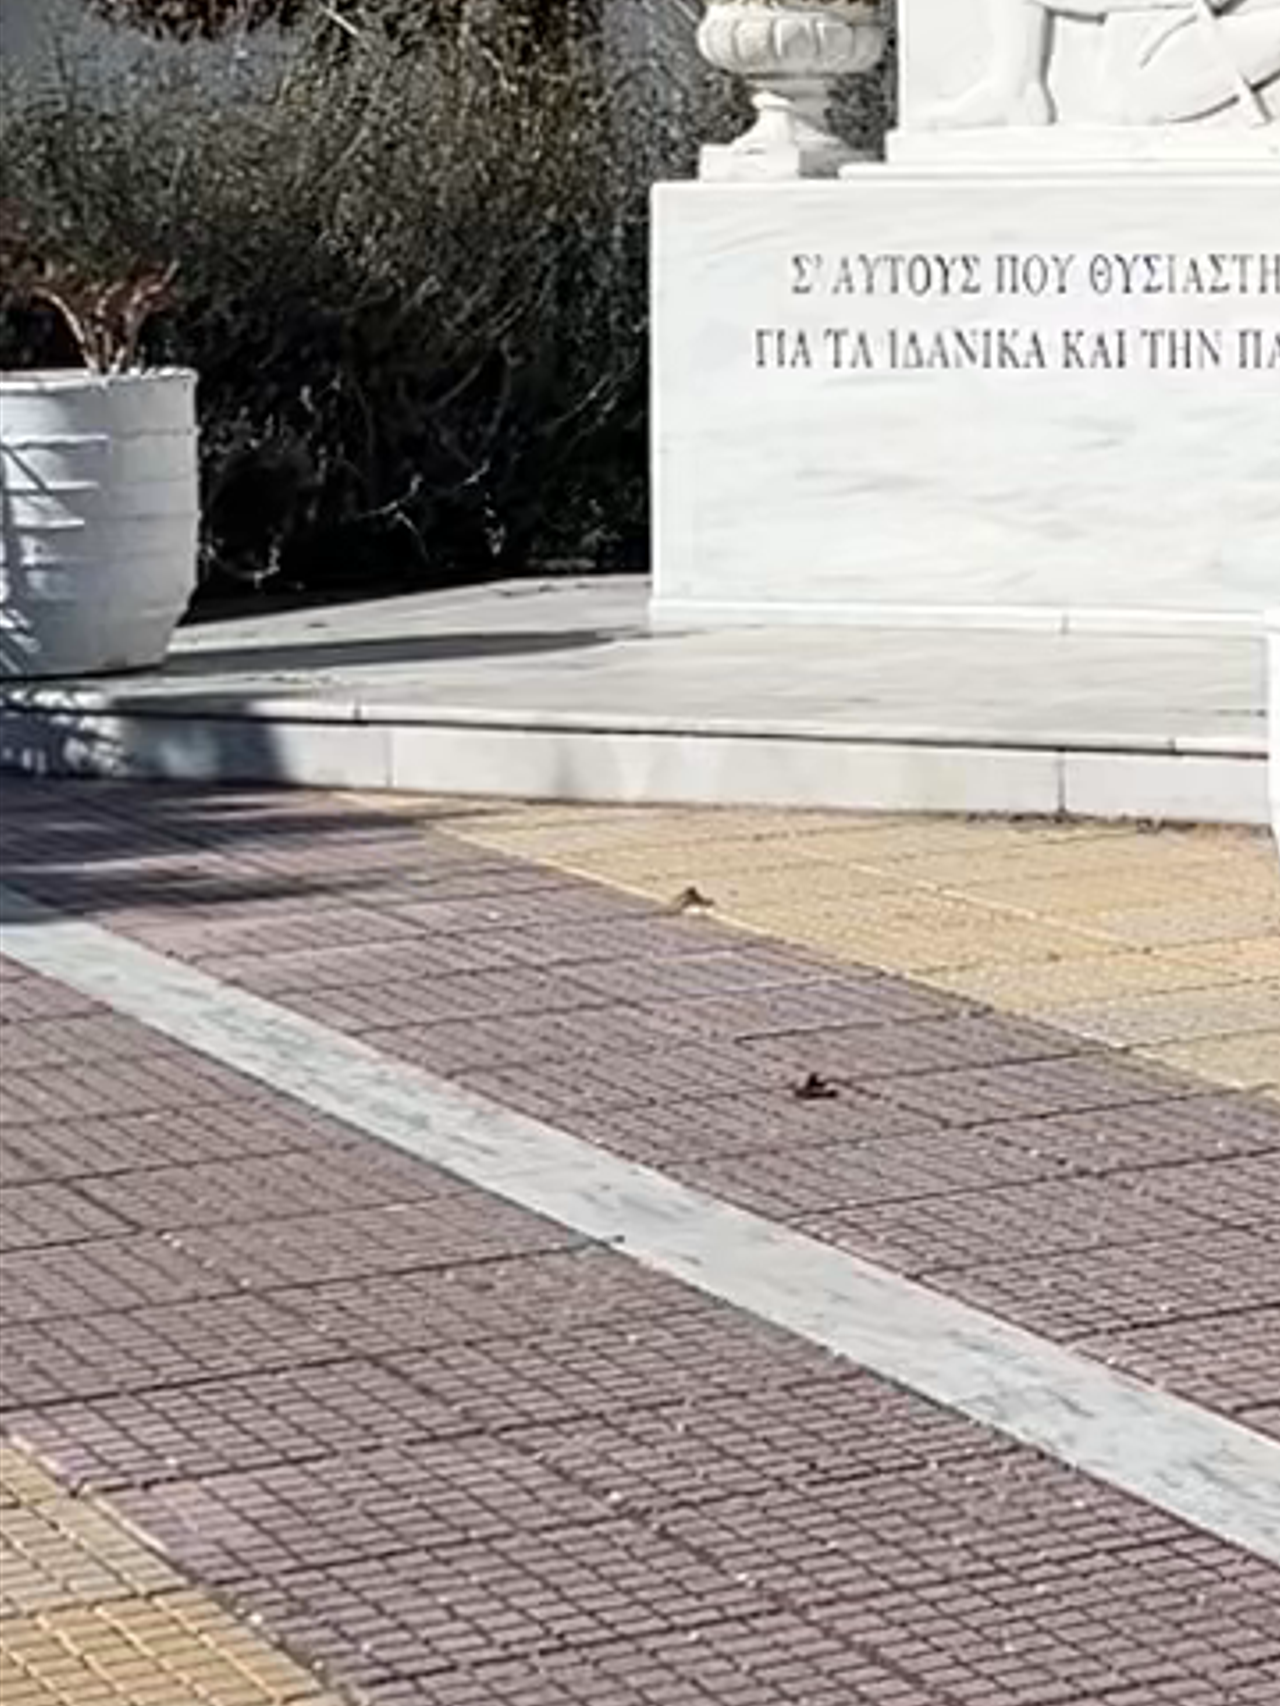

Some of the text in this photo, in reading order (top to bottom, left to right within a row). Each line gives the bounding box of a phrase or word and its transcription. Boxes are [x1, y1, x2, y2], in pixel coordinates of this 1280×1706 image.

[831, 252, 982, 296] ΑΥΤΟΥΣ
[995, 253, 1075, 296] ΠΟΥ
[755, 328, 813, 369] ΓΙΑ
[823, 328, 874, 369] ΤΑ
[888, 328, 1047, 370] ΙΔΑΝΙΚΑ
[1062, 328, 1127, 370] ΚΑΙ
[1140, 328, 1223, 370] ΤΗΝ
